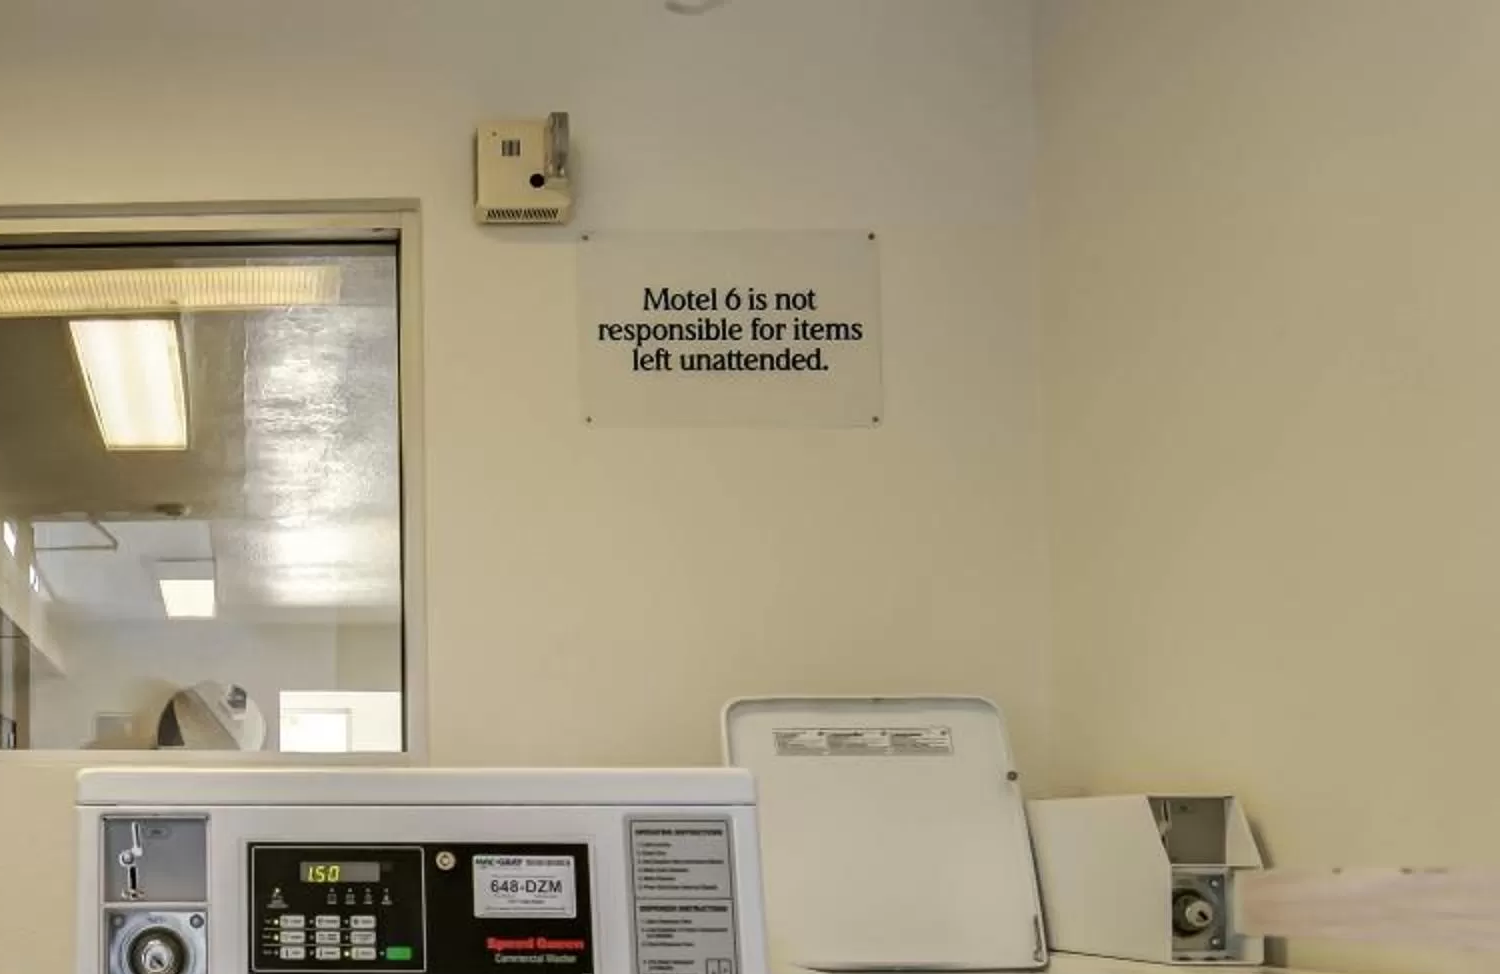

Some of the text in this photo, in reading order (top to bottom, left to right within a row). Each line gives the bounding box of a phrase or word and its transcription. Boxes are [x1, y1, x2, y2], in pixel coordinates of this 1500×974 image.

[643, 287, 817, 311] Motel 6 is not
[598, 318, 863, 345] responsible for items
[632, 348, 829, 371] left unattended.
[490, 879, 563, 893] 648-DZM
